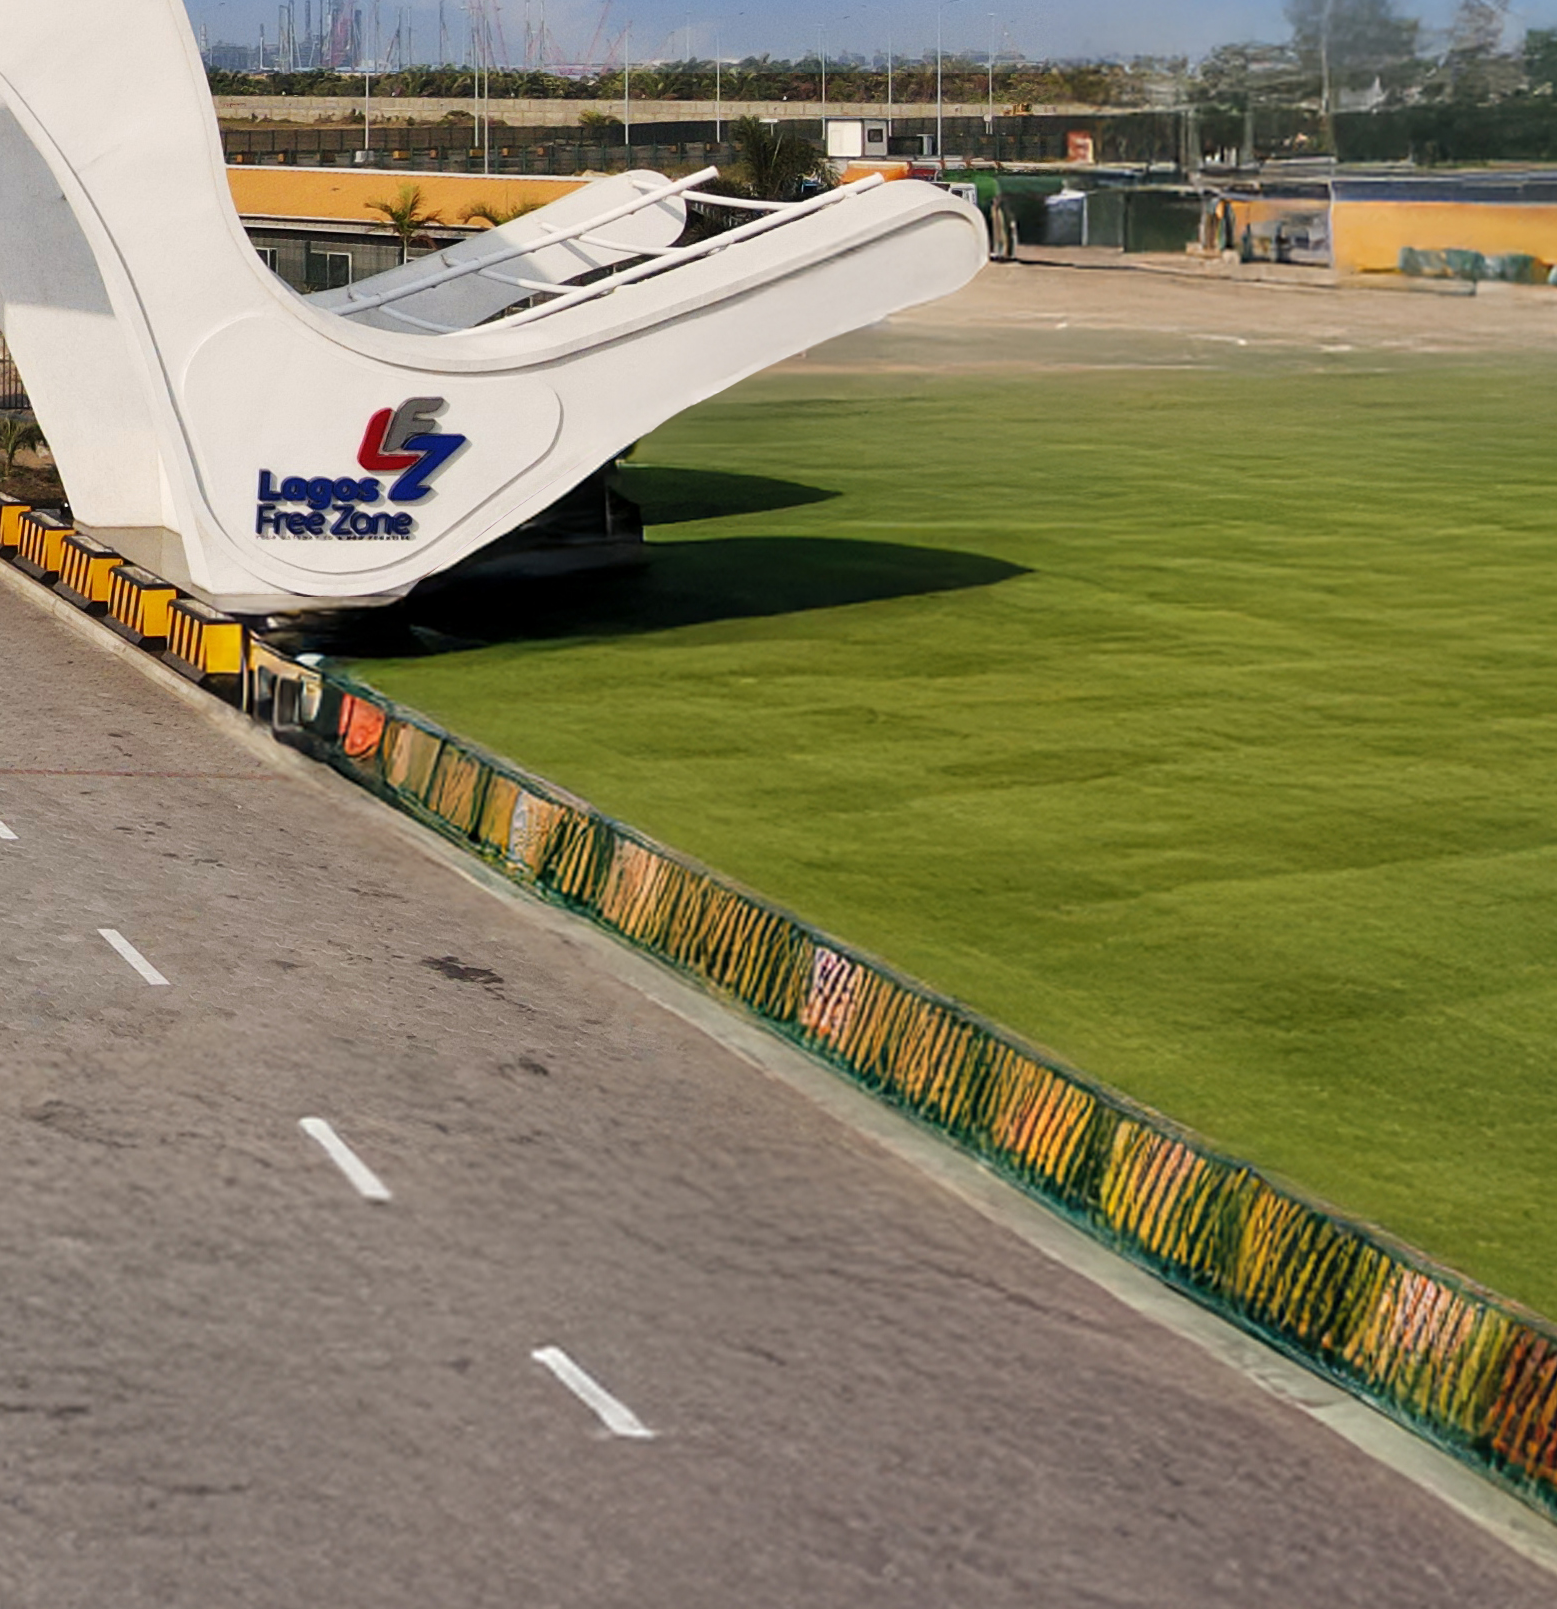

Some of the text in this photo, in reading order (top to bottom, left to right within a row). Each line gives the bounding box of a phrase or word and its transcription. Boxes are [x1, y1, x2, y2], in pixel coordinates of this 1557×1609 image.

[257, 469, 380, 510] Lagos
[255, 503, 413, 535] Free Zone
